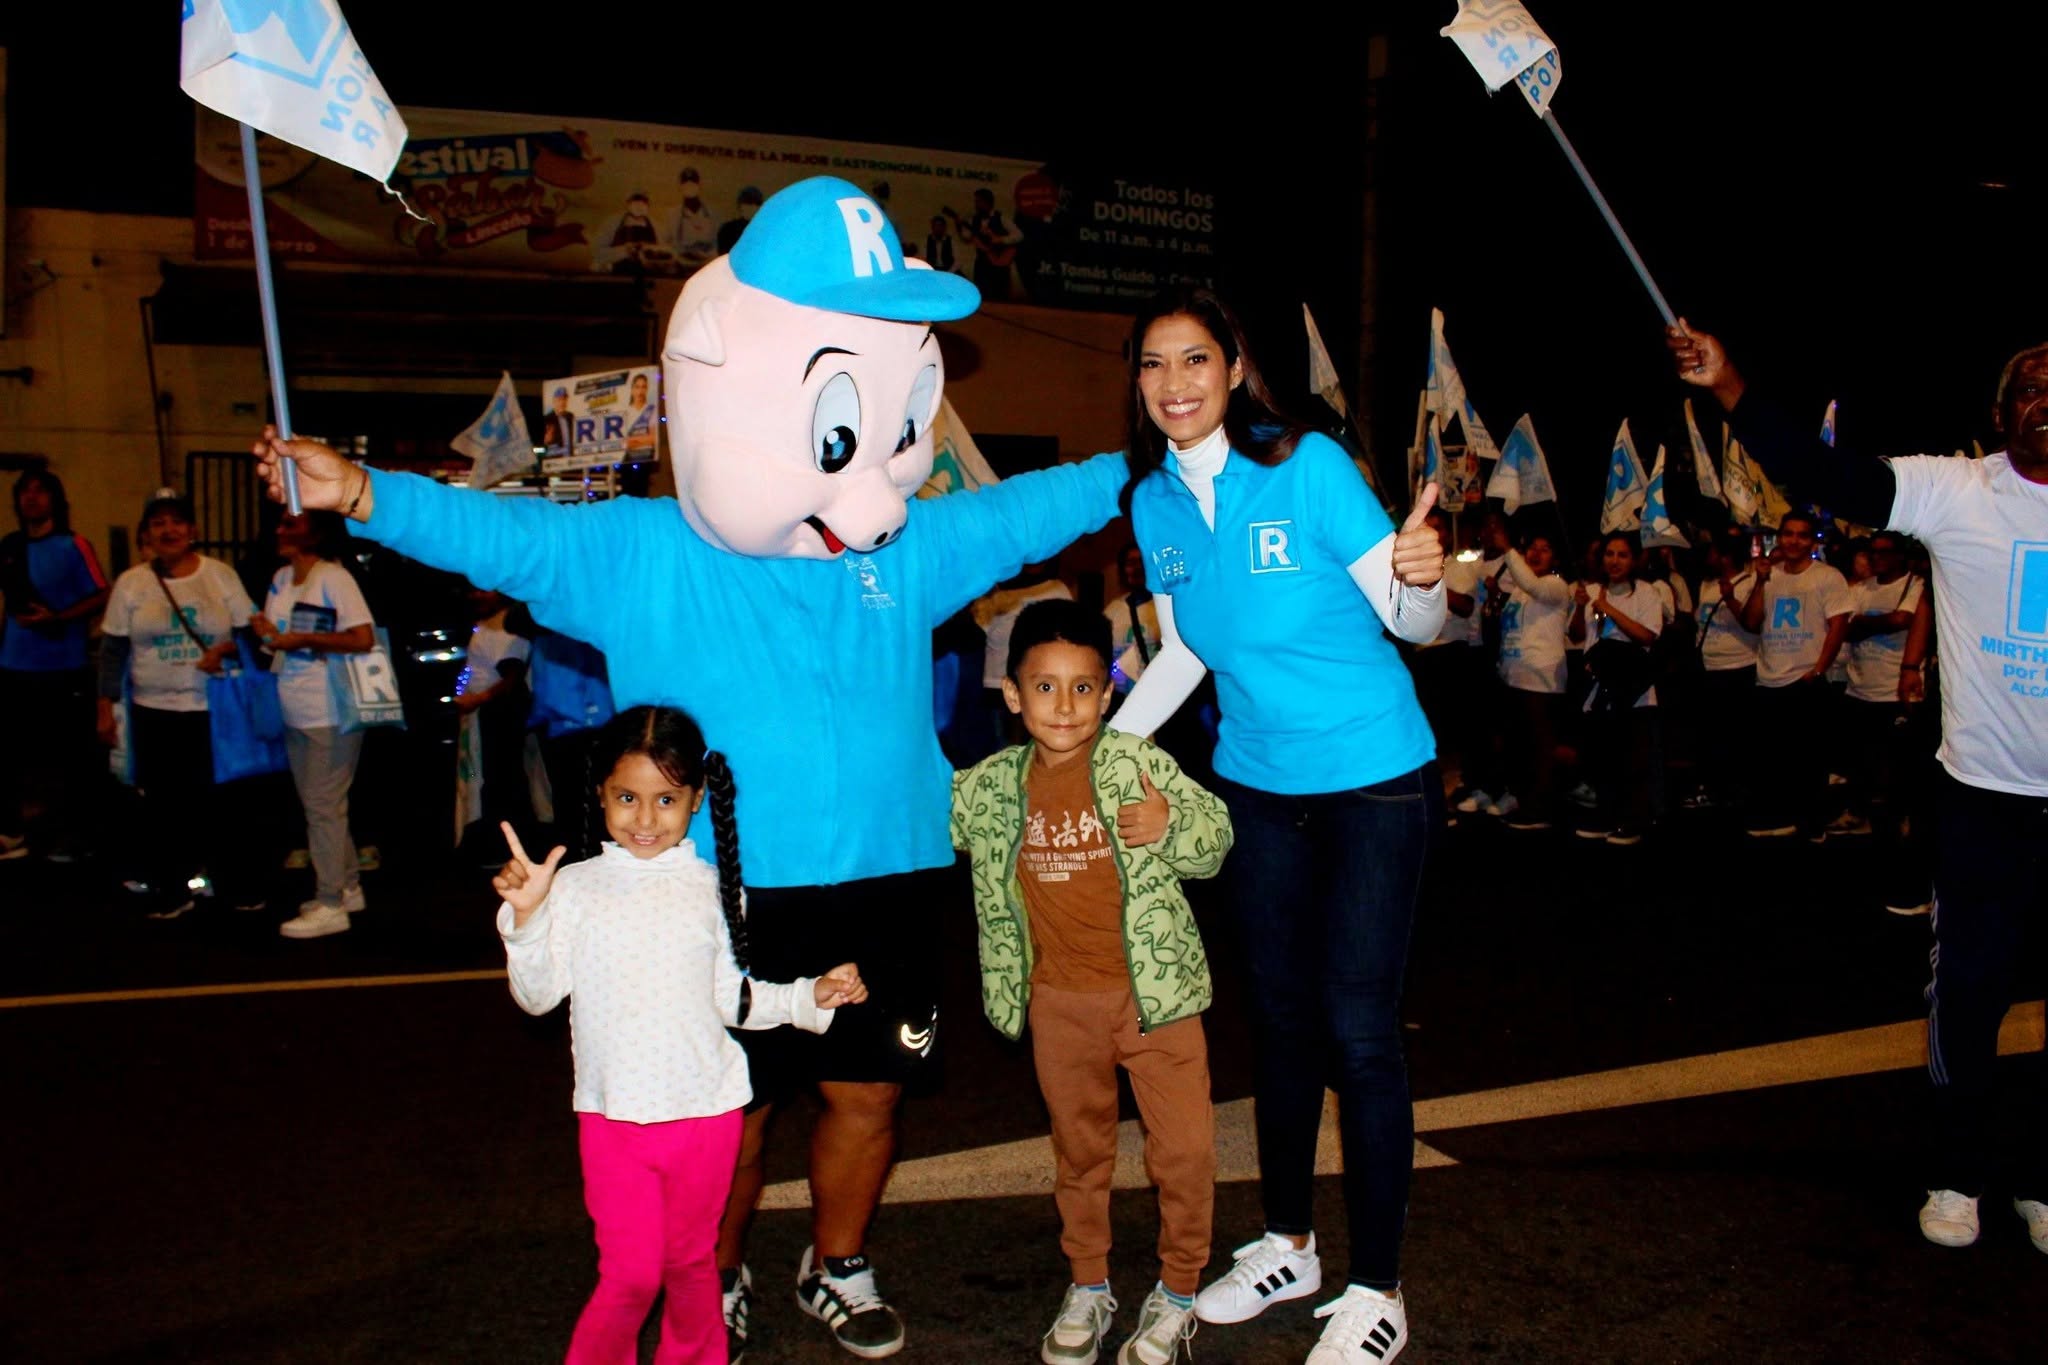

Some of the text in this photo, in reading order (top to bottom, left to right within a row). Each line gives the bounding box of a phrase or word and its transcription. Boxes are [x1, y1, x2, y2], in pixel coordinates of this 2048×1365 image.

[397, 137, 529, 176] estival
[652, 141, 659, 151] Y
[664, 142, 734, 158] DISFRUTA
[737, 149, 756, 161] DE
[759, 151, 778, 162] LA
[782, 153, 829, 166] MEJOR
[832, 157, 932, 177] GASTRONOMÍA
[936, 167, 953, 177] DE
[1113, 179, 1214, 210] Todos los
[1093, 199, 1215, 234] DOMINGOS
[836, 197, 894, 278] R
[1080, 227, 1099, 242] De
[1104, 230, 1117, 244] 11
[1170, 238, 1178, 250] 4
[576, 415, 625, 443] R R
[1260, 527, 1292, 567] R
[1773, 598, 1801, 629] R
[1981, 635, 2048, 664] MIRTH
[354, 653, 400, 703] R
[2003, 663, 2039, 680] por
[2010, 681, 2048, 698] ALCA
[1046, 852, 1052, 862] A
[1087, 846, 1112, 860] SPIRIT
[1049, 861, 1088, 872] STRANDED
